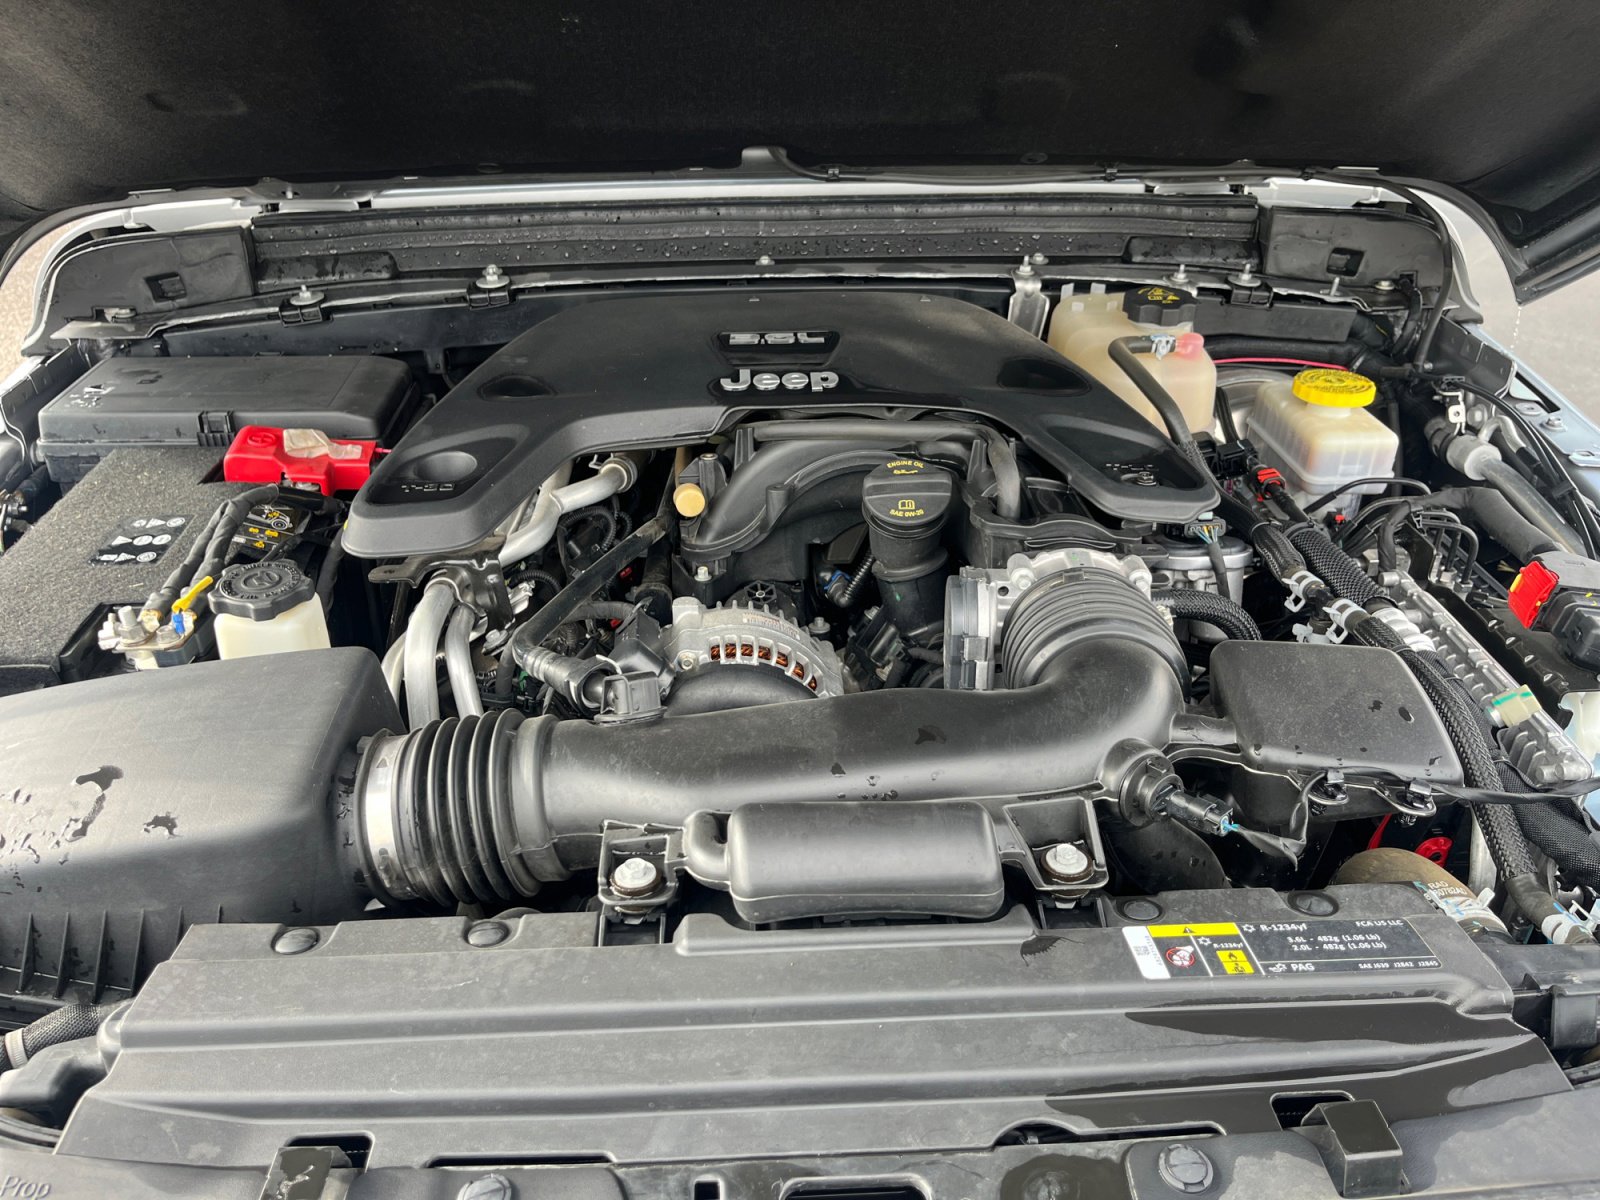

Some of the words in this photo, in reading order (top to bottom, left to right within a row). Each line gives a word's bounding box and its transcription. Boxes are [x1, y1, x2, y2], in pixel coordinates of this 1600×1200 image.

[720, 368, 839, 392] Jeep
[886, 460, 912, 468] ENGINE
[913, 460, 924, 468] OIL
[889, 509, 903, 517] SAE
[1259, 923, 1308, 932] R-1234yf
[1355, 920, 1374, 928] FCA
[1374, 919, 1387, 927] US
[1317, 935, 1340, 943] 482g
[1291, 943, 1313, 951] 2.0L
[1322, 943, 1346, 951] 482g
[1290, 963, 1316, 972] PAG
[0, 1174, 52, 1200] Prop
